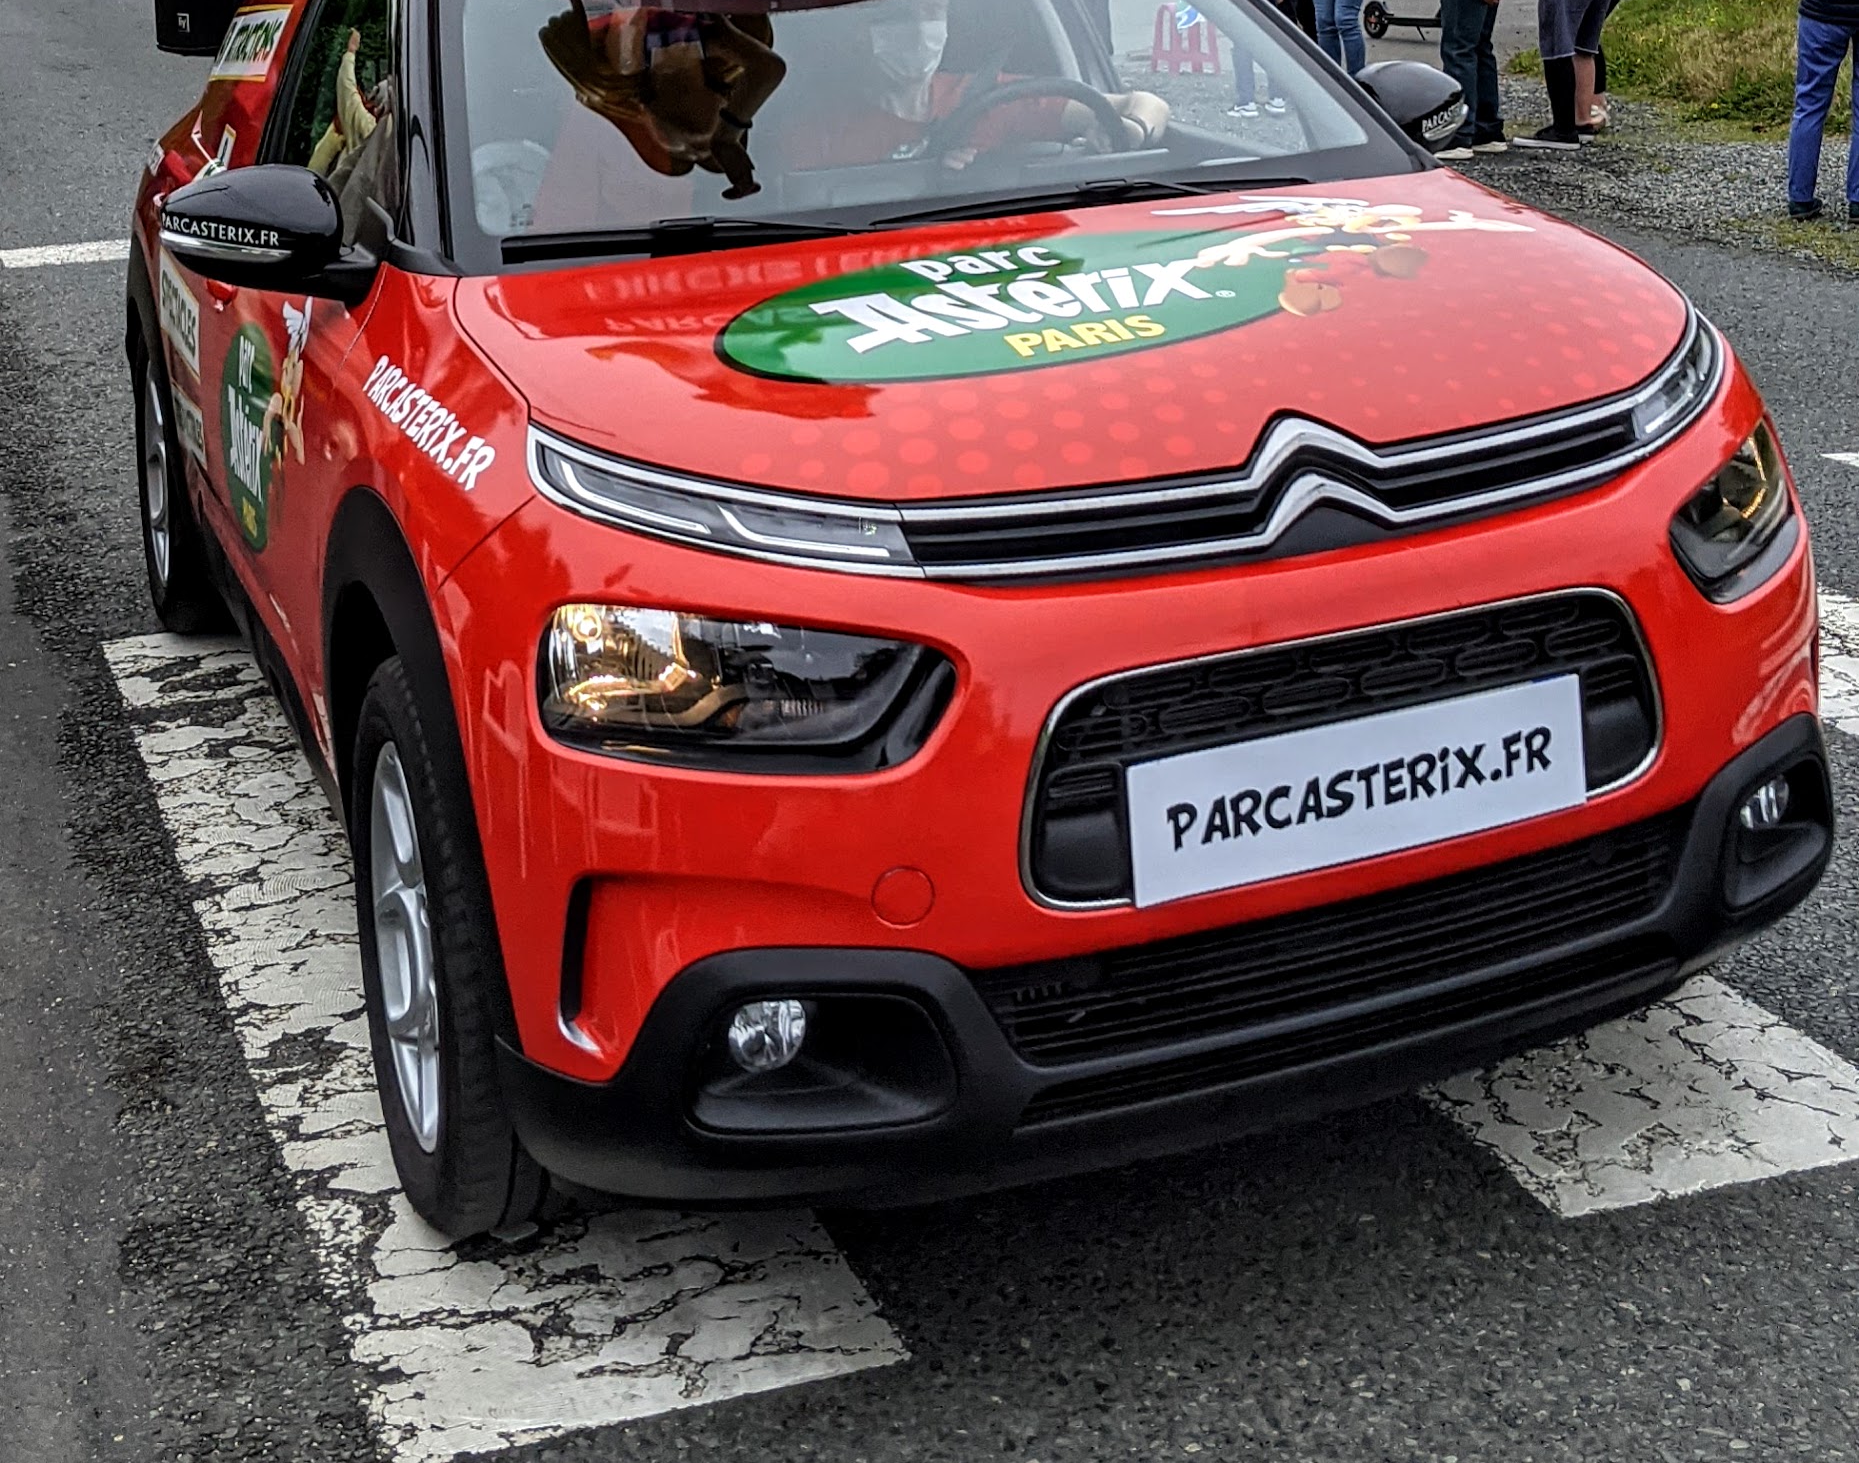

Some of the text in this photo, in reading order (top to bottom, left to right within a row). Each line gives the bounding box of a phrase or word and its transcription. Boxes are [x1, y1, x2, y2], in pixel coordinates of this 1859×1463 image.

[808, 258, 1214, 354] Astérix
[901, 247, 1062, 282] parc
[1003, 315, 1166, 357] PARIS
[362, 354, 497, 492] PARCASTERiX.FR
[1166, 725, 1552, 852] PARCASTERiX.FR
